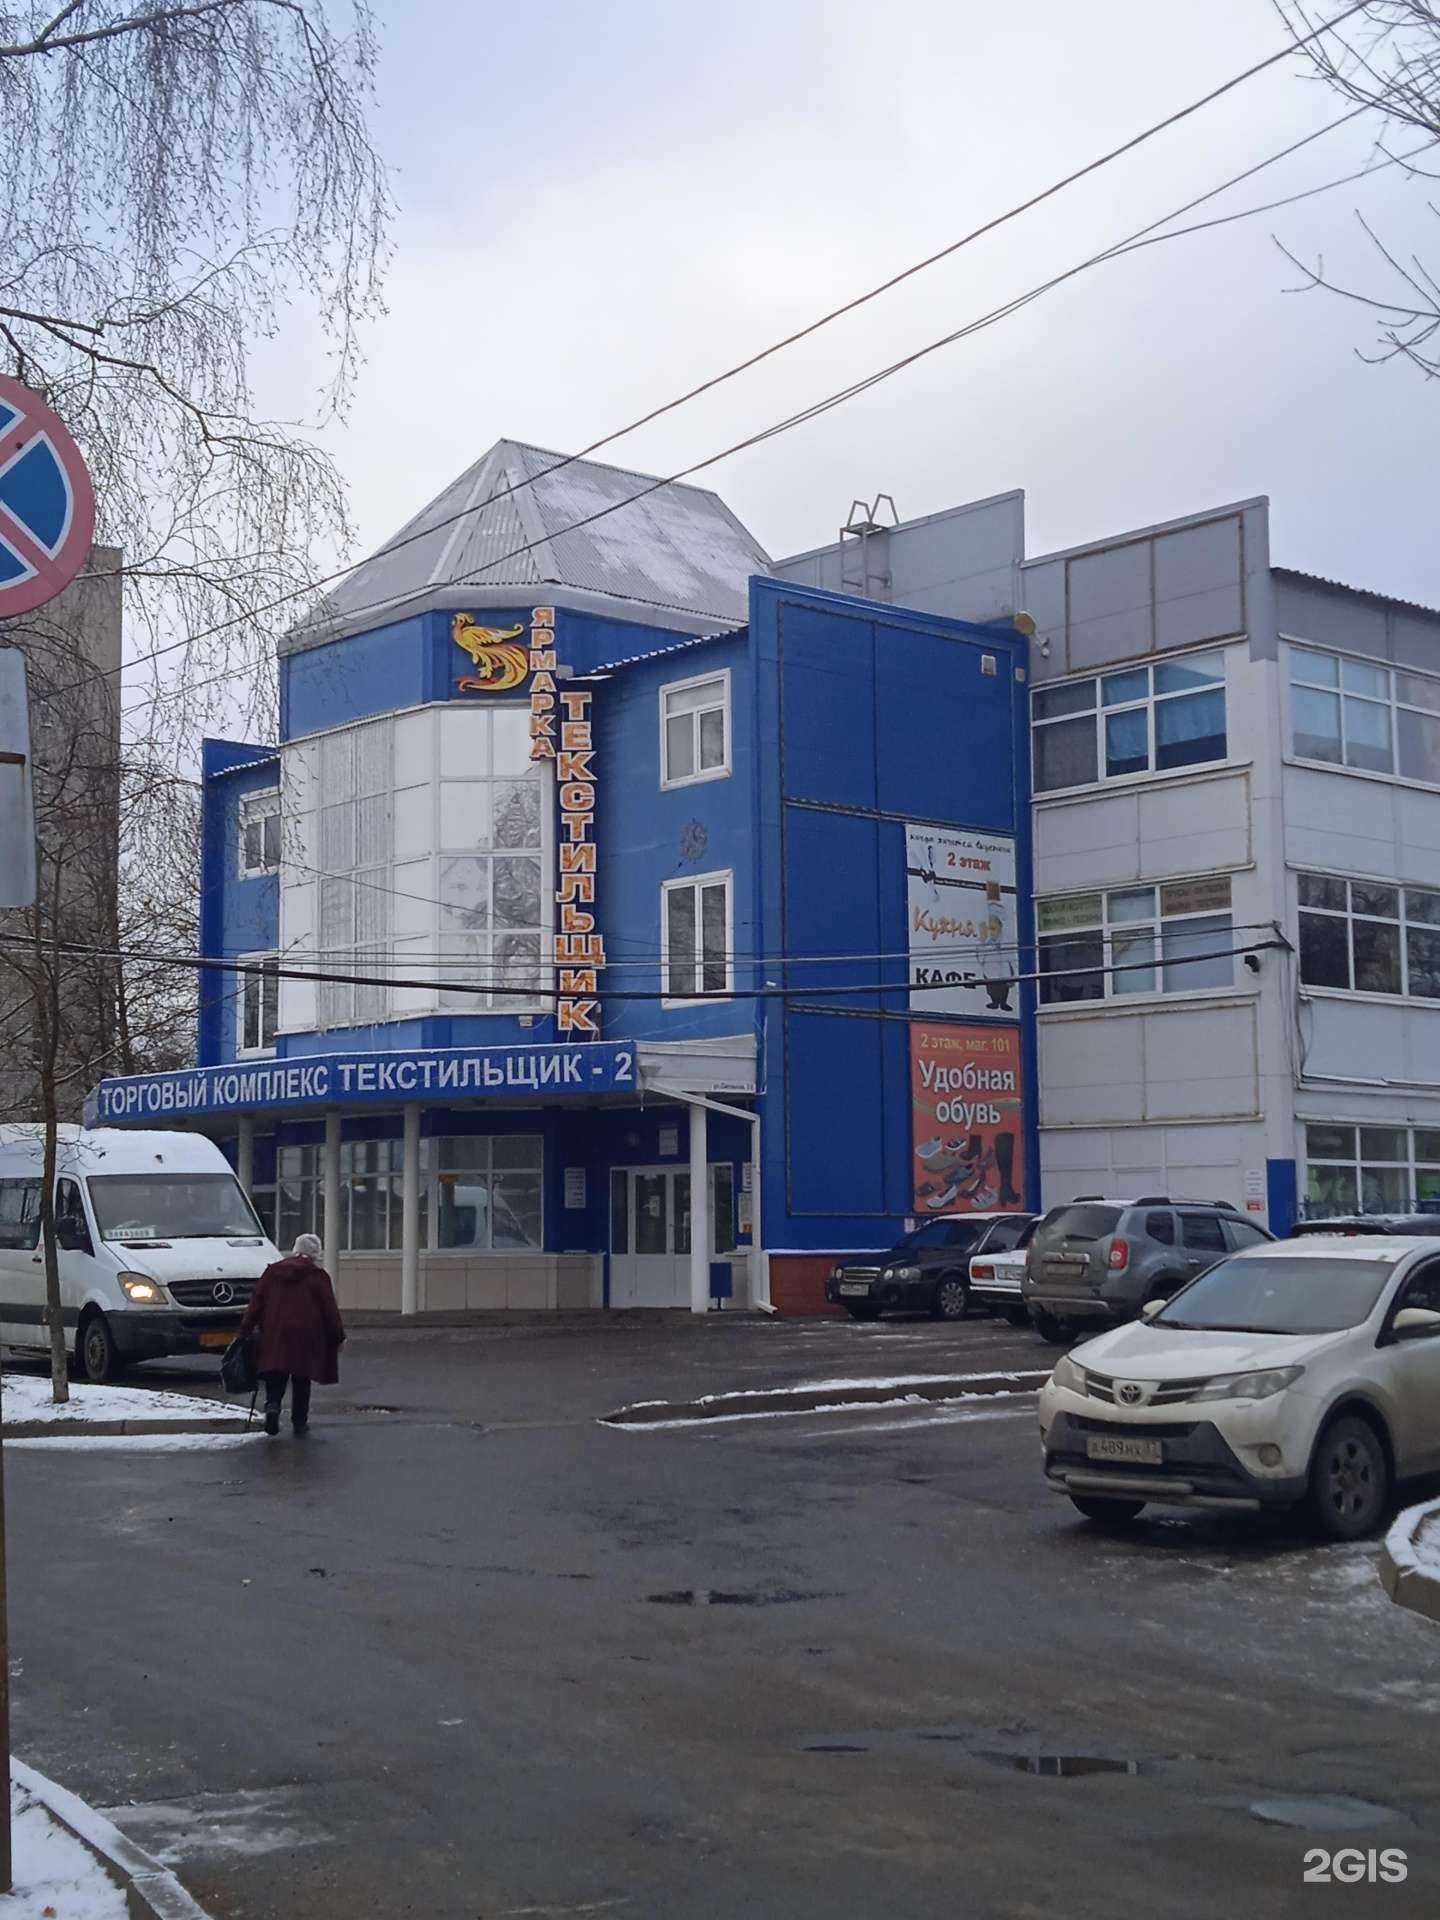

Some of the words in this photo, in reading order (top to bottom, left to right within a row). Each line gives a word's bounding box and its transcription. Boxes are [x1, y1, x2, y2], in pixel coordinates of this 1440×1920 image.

[529, 606, 558, 759] ЯРМАРКА
[554, 691, 606, 1031] ТЕКСТИЛЬЩИК
[947, 852, 956, 867] 2
[960, 857, 991, 871] этаж
[915, 967, 976, 989] КАФЕ
[921, 1033, 929, 1048] 2
[991, 1038, 1010, 1054] 101
[102, 1073, 207, 1115] ТОРГОВЫЙ
[212, 1065, 329, 1105] КОМПЛЕКС
[339, 1053, 583, 1091] ТЕКСТИЛЬЩИК
[614, 1052, 632, 1081] 2
[918, 1059, 1016, 1093] Удобная
[936, 1095, 1001, 1130] обувь
